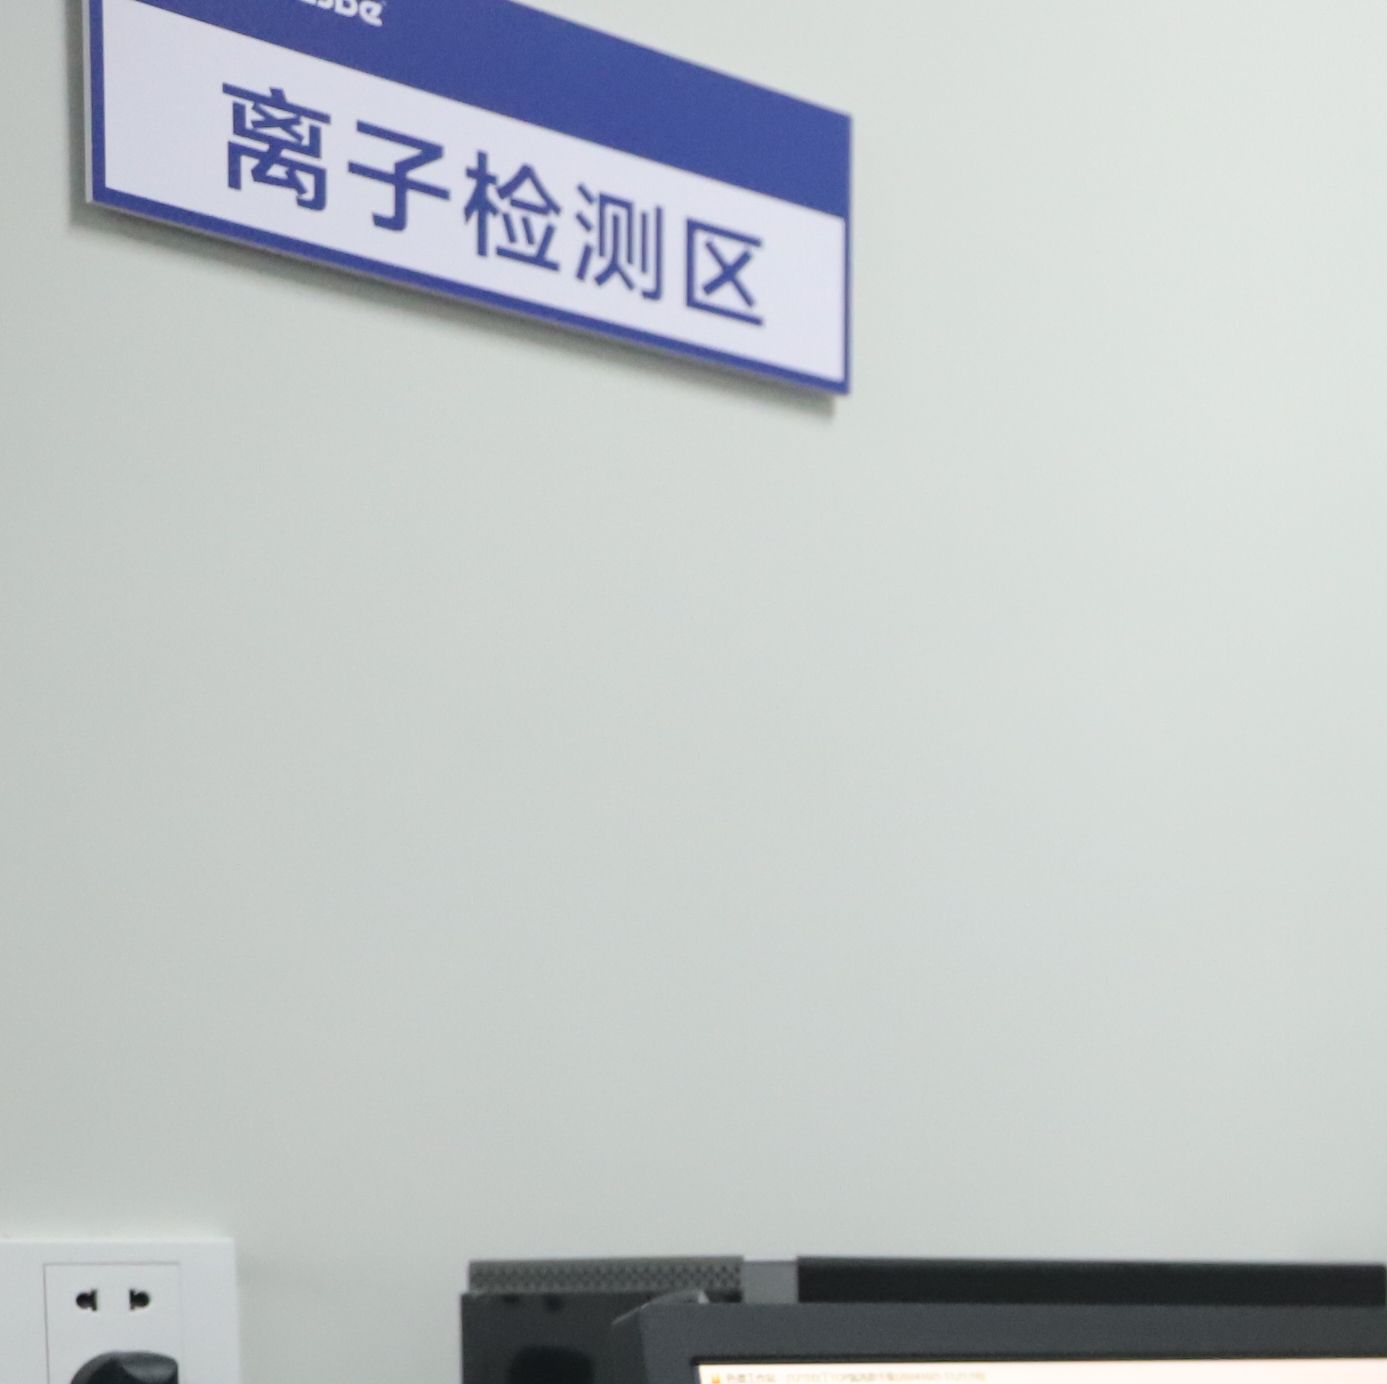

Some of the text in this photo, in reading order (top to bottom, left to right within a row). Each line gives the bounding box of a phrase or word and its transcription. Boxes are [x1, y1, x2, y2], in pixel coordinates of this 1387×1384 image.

[220, 81, 765, 327] 离子检测区
